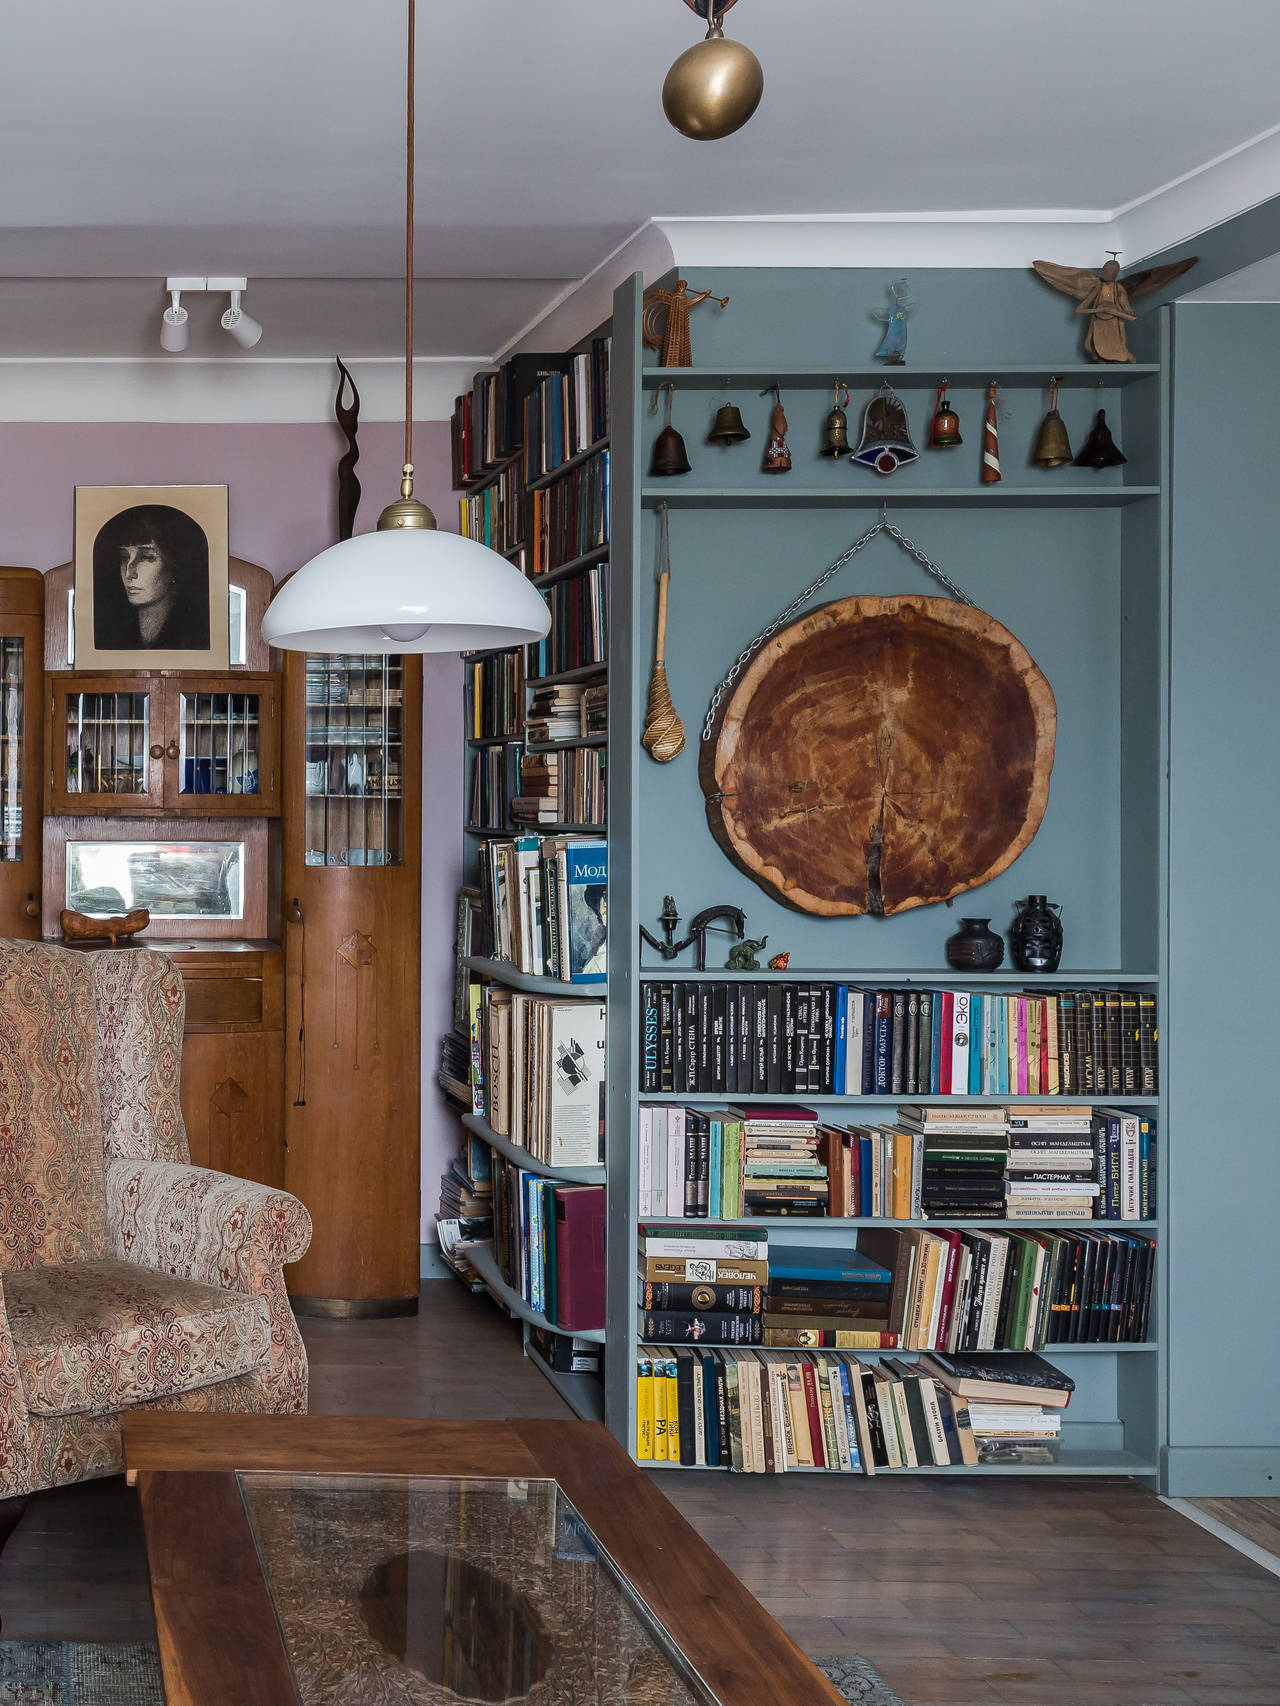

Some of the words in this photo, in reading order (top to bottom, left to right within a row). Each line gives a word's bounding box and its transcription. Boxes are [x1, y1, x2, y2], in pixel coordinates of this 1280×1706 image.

[955, 996, 968, 1025] Эко
[645, 1007, 658, 1071] ULYSSES
[688, 1024, 696, 1050] СТЕНА
[879, 1018, 887, 1054] ФАУСТУС
[878, 1055, 886, 1087] ДОКТОР
[1032, 1173, 1071, 1181] ПАСТЕРНАК
[1099, 1155, 1107, 1188] ХАЗАРСКИЙ
[1111, 1152, 1119, 1179] БИГЛ
[655, 1263, 686, 1271] LEGENS
[718, 1272, 757, 1280] ЧЕЛОВЕК
[913, 1304, 921, 1328] СТИВЕН
[929, 1401, 940, 1421] ЭЗОПА
[656, 1419, 666, 1436] РА
[935, 1421, 944, 1443] БАСНИ
